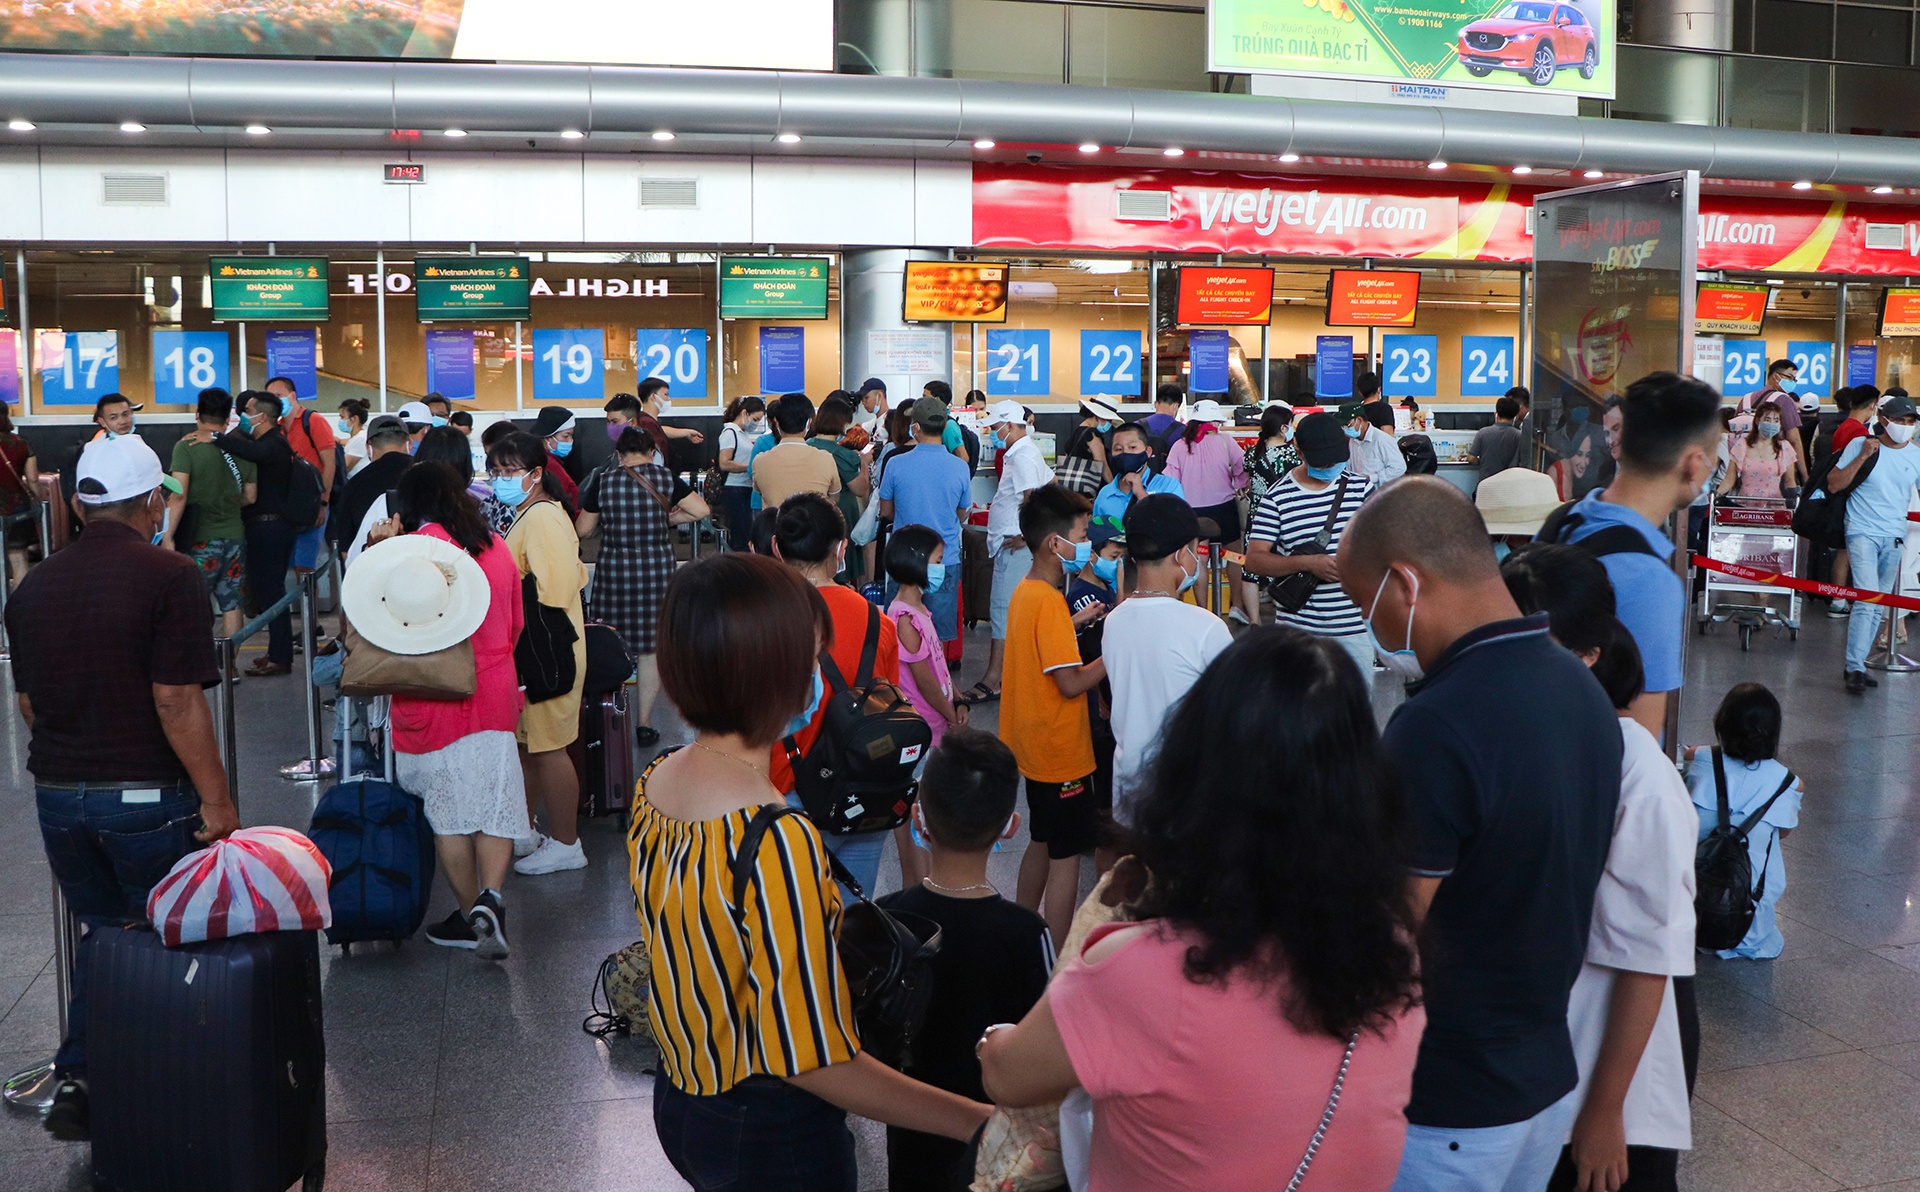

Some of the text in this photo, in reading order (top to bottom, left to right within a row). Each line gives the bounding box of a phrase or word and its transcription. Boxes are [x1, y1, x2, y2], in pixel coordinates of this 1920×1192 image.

[1262, 21, 1279, 32] Bay
[1281, 22, 1303, 33] Xuân
[1306, 25, 1328, 35] Canh
[1374, 6, 1467, 20] www.bambooairways.com
[1407, 18, 1443, 28] 1900 1166
[1232, 32, 1368, 64] TRÚNG QUÀ BẠC TỈ
[391, 166, 420, 178] 17:42
[259, 292, 282, 300] Group
[462, 292, 484, 300] Group
[62, 348, 106, 390] 17
[164, 346, 217, 389] 18
[542, 344, 593, 385] 19
[646, 343, 699, 384] 20
[996, 343, 1039, 382] 21
[1089, 344, 1134, 382] 22
[1389, 347, 1431, 384] 23
[1467, 348, 1509, 384] 24
[1724, 352, 1761, 385] 25
[1793, 353, 1827, 386] 26
[1739, 513, 1775, 521] AGRIBANK
